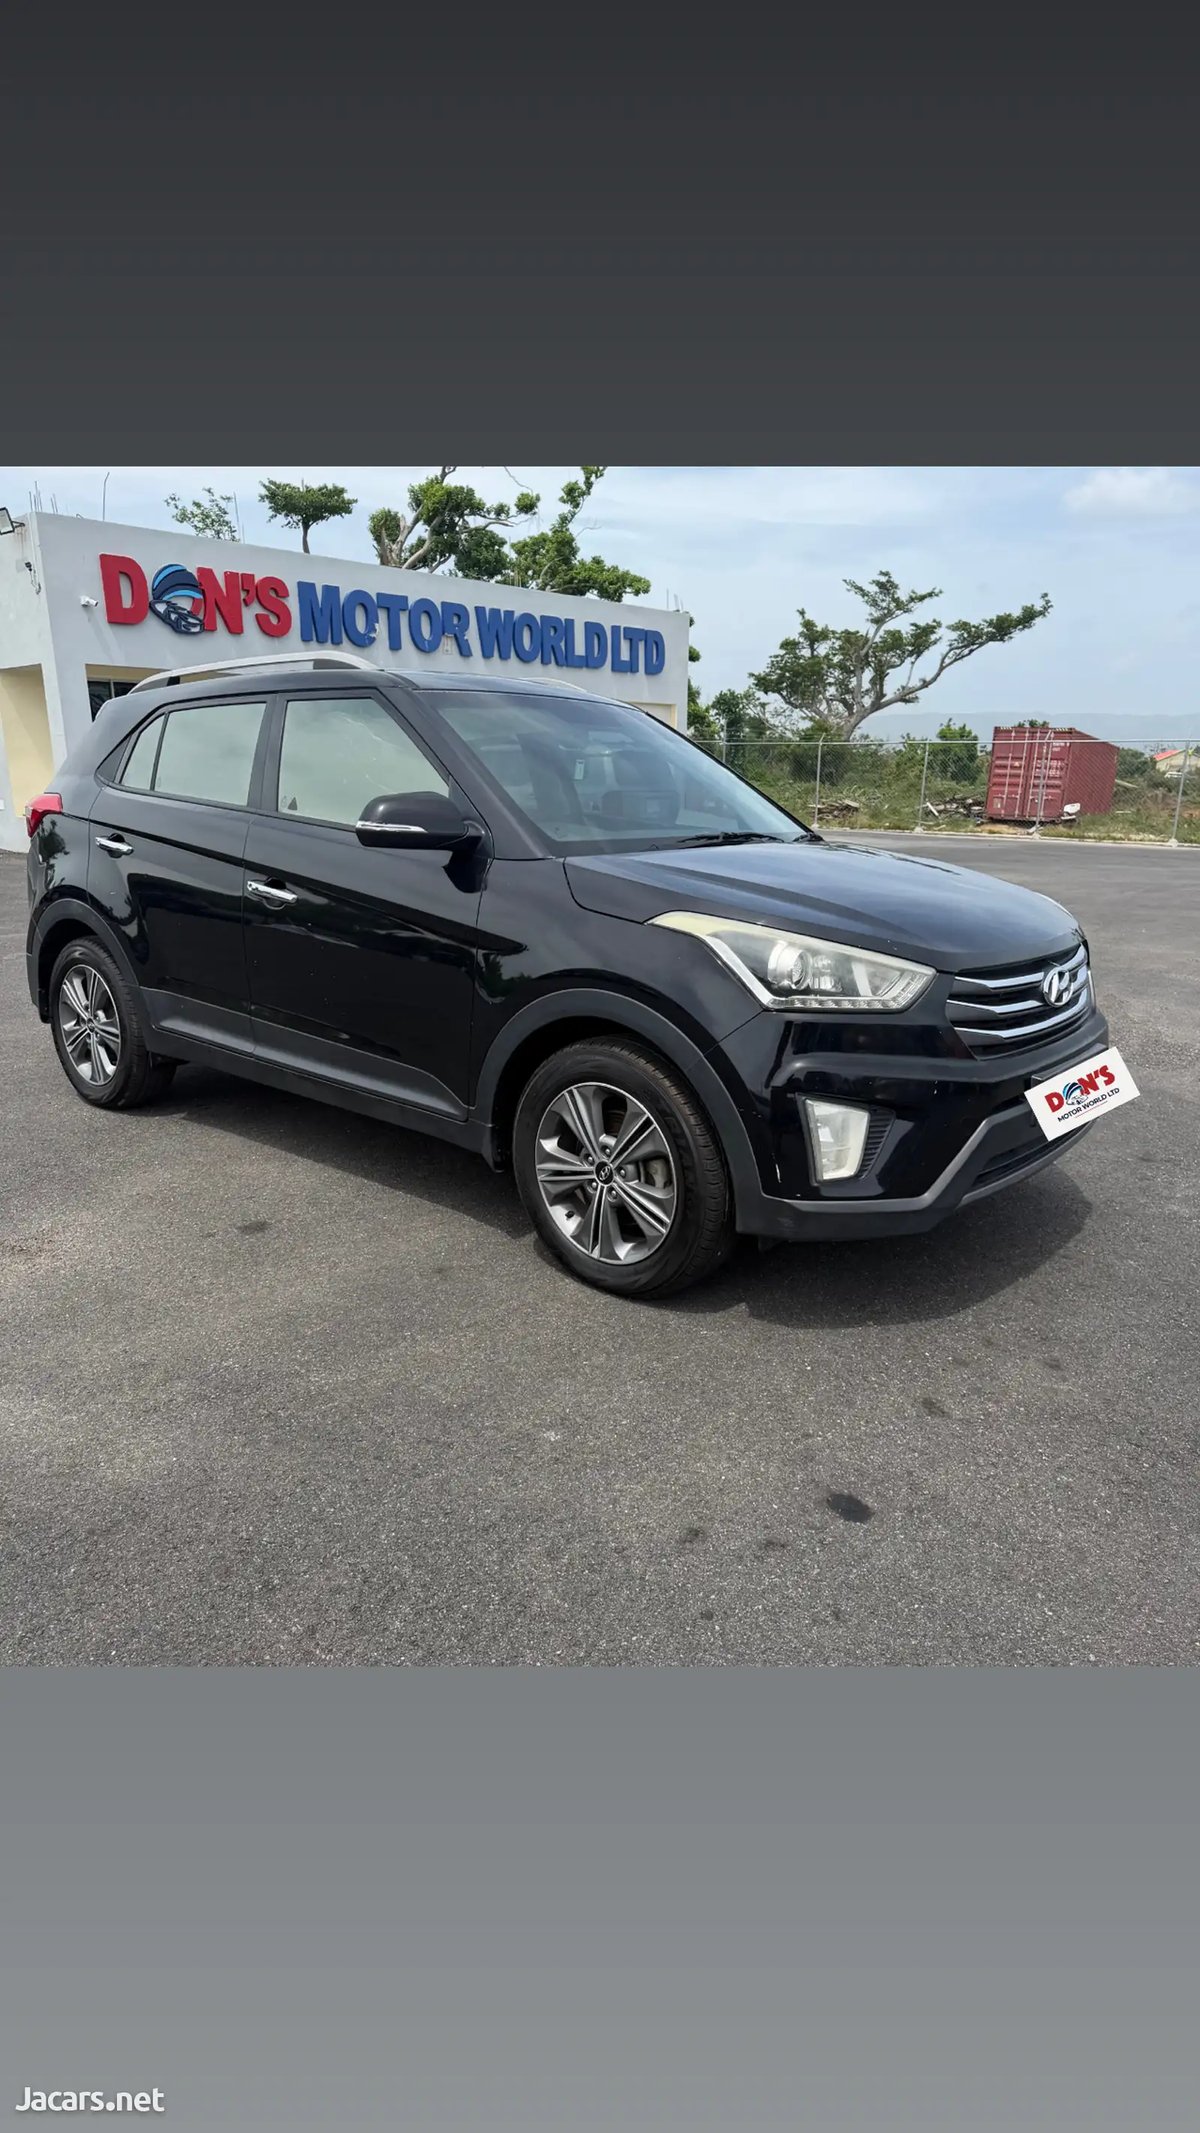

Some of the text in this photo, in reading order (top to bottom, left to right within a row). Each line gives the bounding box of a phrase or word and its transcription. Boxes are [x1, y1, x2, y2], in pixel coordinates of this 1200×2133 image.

[297, 580, 473, 657] MOTOR
[475, 605, 608, 670] WORLD
[611, 625, 666, 676] LTD
